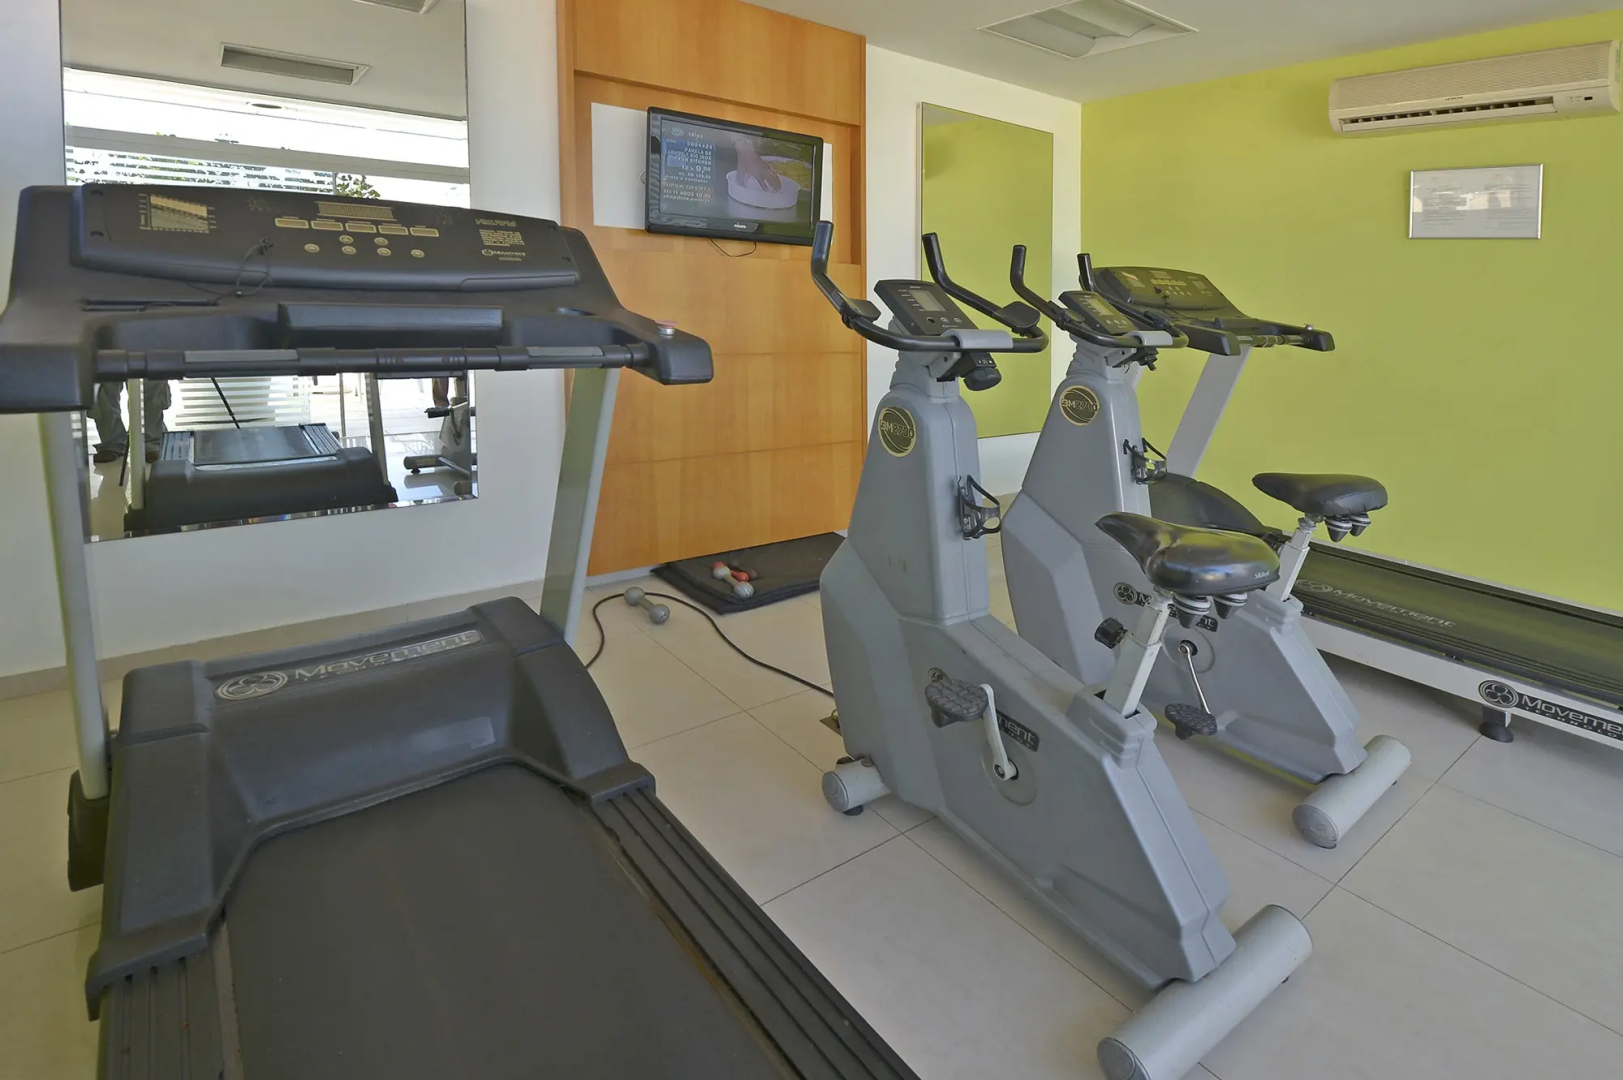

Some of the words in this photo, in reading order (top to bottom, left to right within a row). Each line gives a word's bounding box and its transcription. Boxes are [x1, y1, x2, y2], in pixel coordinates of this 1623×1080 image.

[1332, 589, 1457, 628] Movement
[295, 630, 475, 680] Movement
[1522, 695, 1623, 735] Moveme
[1526, 706, 1623, 740] TECHNOLO
